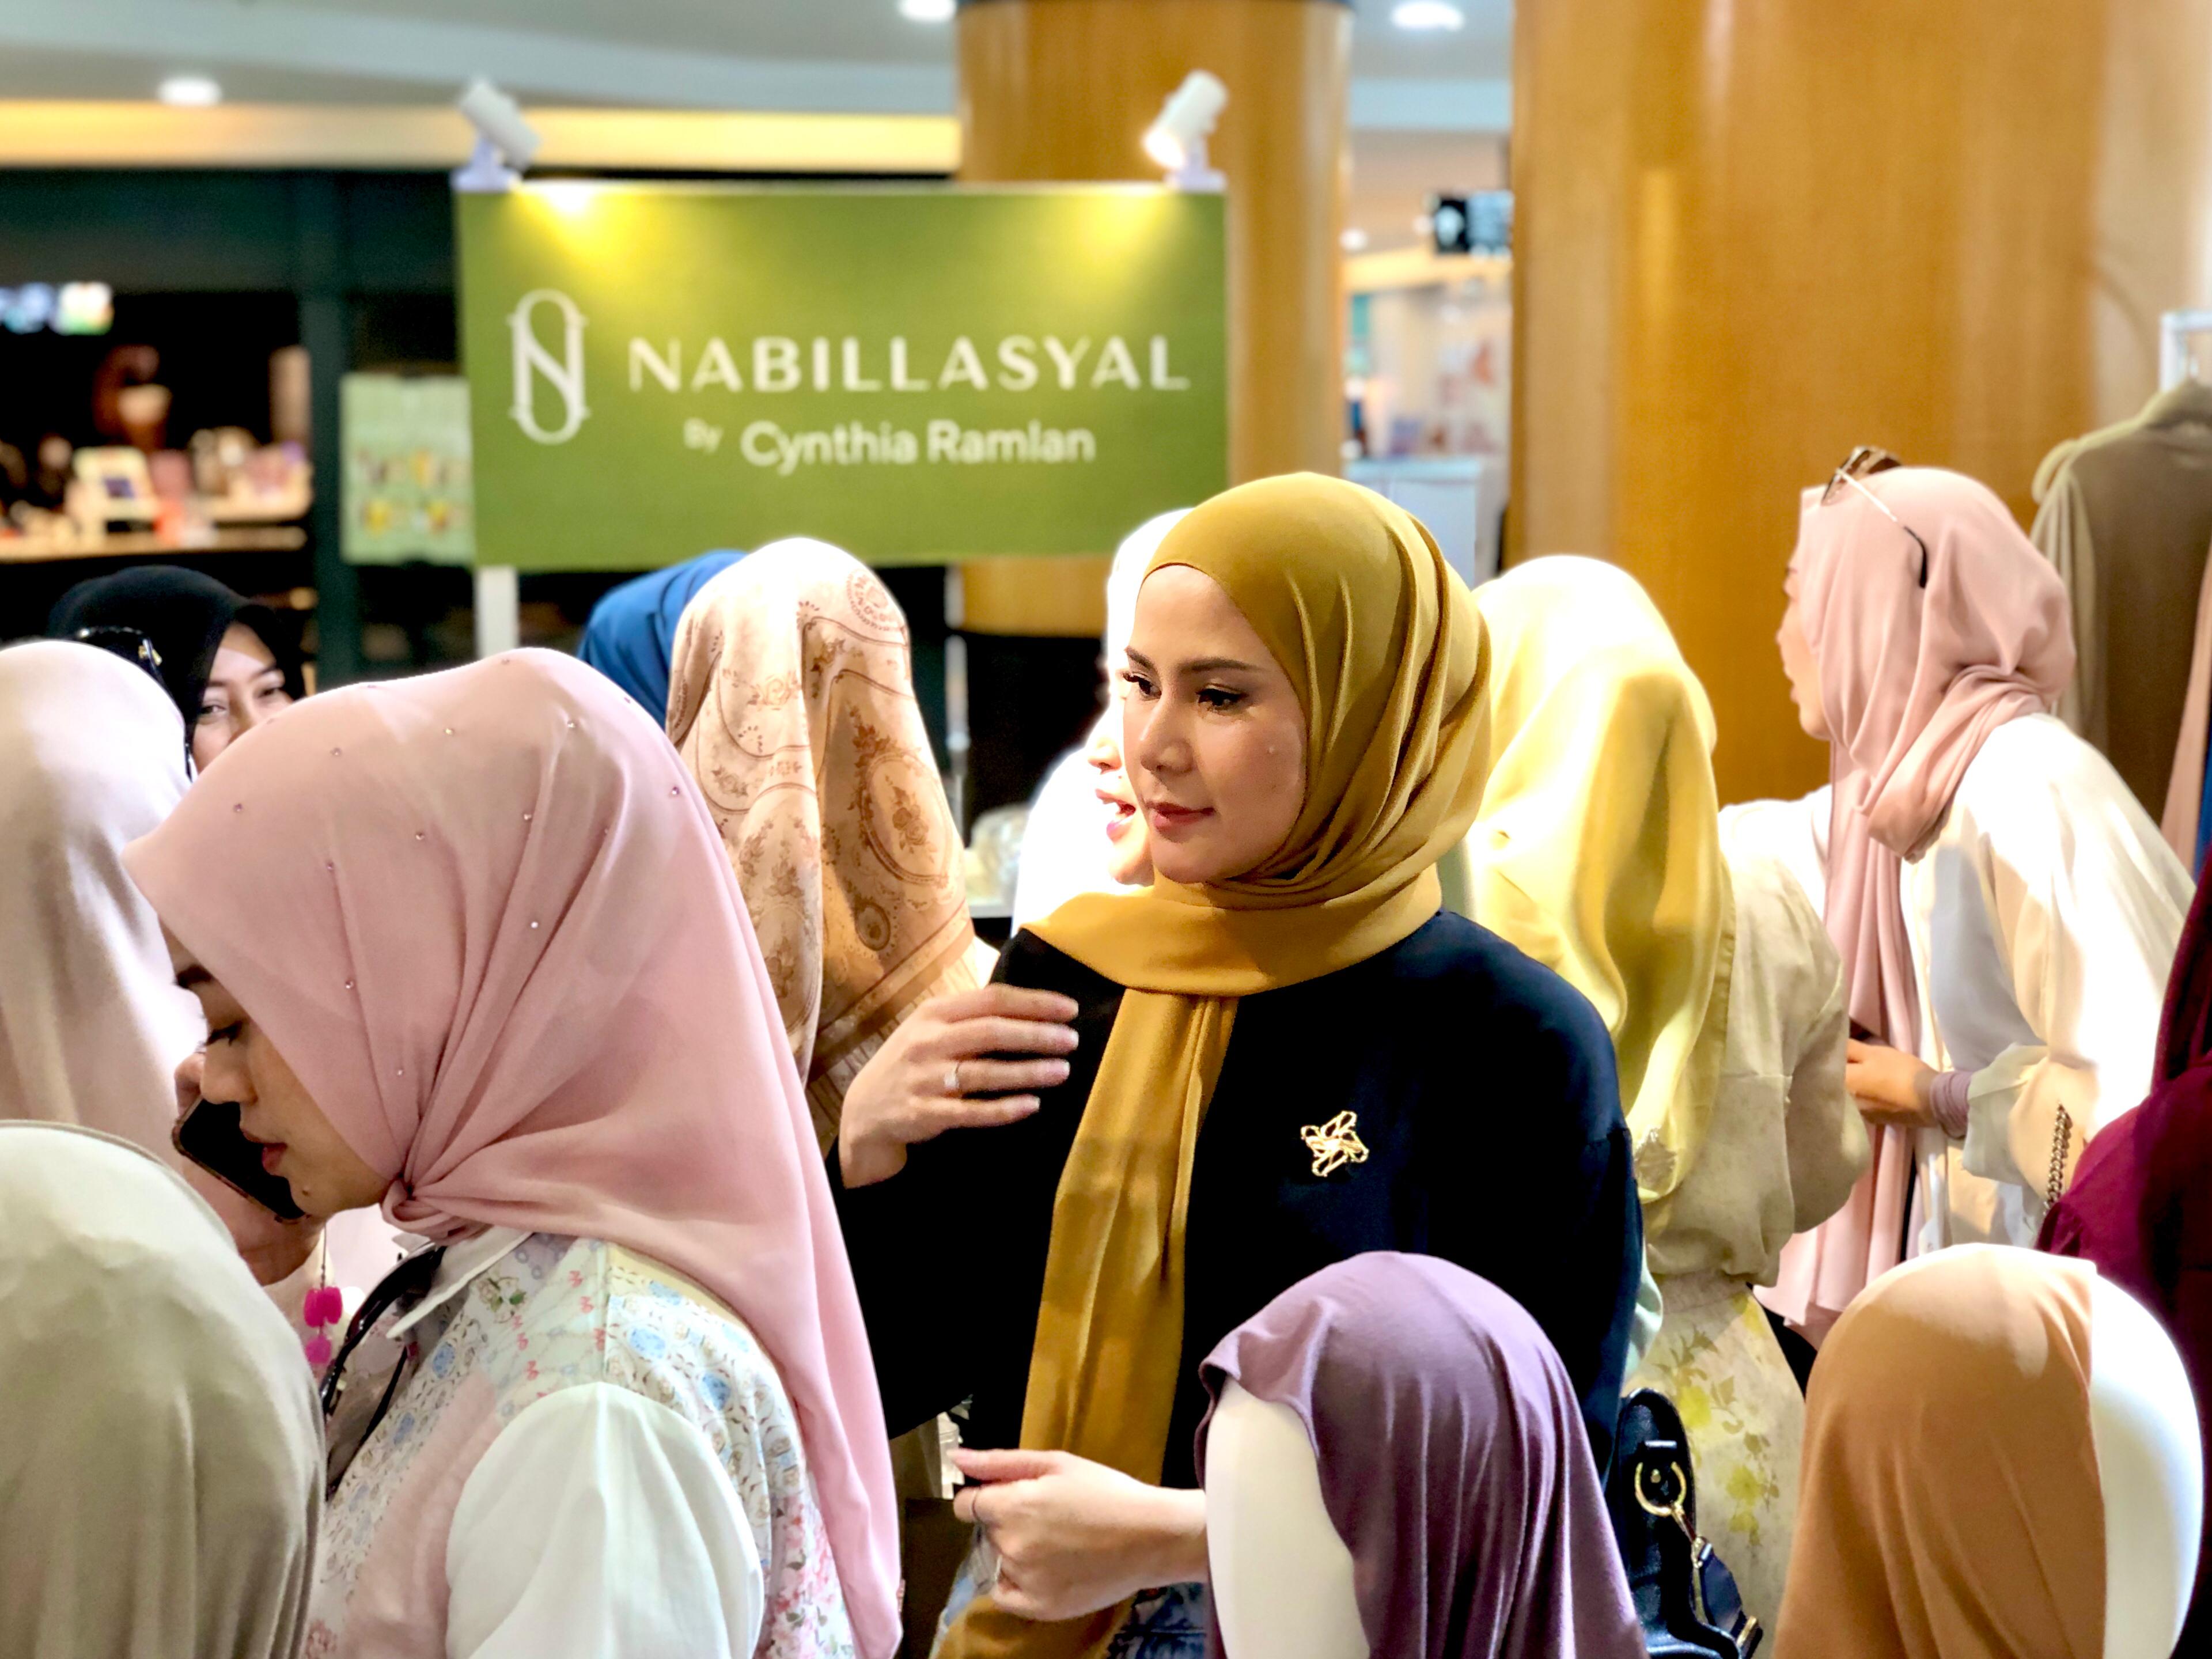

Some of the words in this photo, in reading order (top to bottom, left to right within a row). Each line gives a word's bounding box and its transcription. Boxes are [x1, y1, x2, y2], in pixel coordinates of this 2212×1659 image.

[628, 335, 1190, 393] NABILLASYAL
[683, 418, 724, 454] By
[740, 420, 919, 476] Cynthia
[926, 418, 1096, 464] Ramlan
